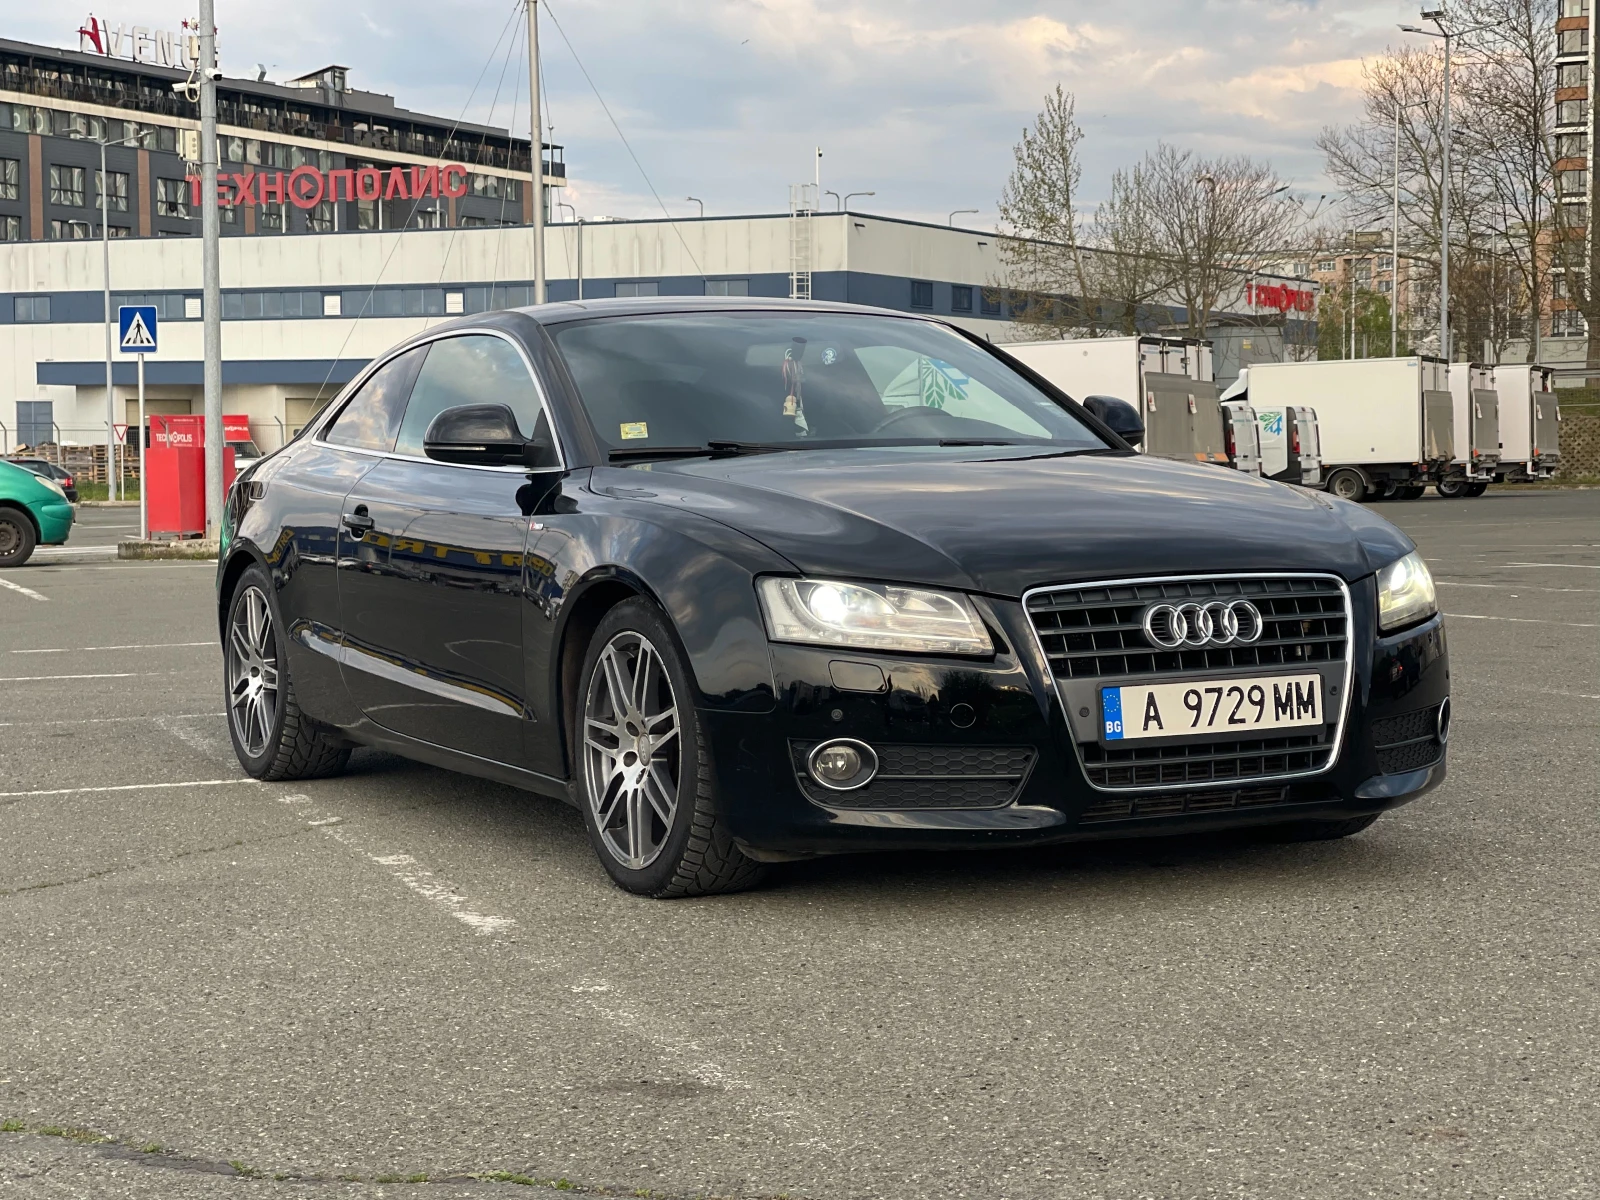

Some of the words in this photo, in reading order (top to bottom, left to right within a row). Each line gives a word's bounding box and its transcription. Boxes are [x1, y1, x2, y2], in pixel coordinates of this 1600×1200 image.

[156, 431, 192, 443] TECNOPOLIS
[1143, 692, 1164, 731] A
[1183, 684, 1265, 728] 9729
[1273, 680, 1317, 722] MM
[1106, 720, 1122, 734] BG
